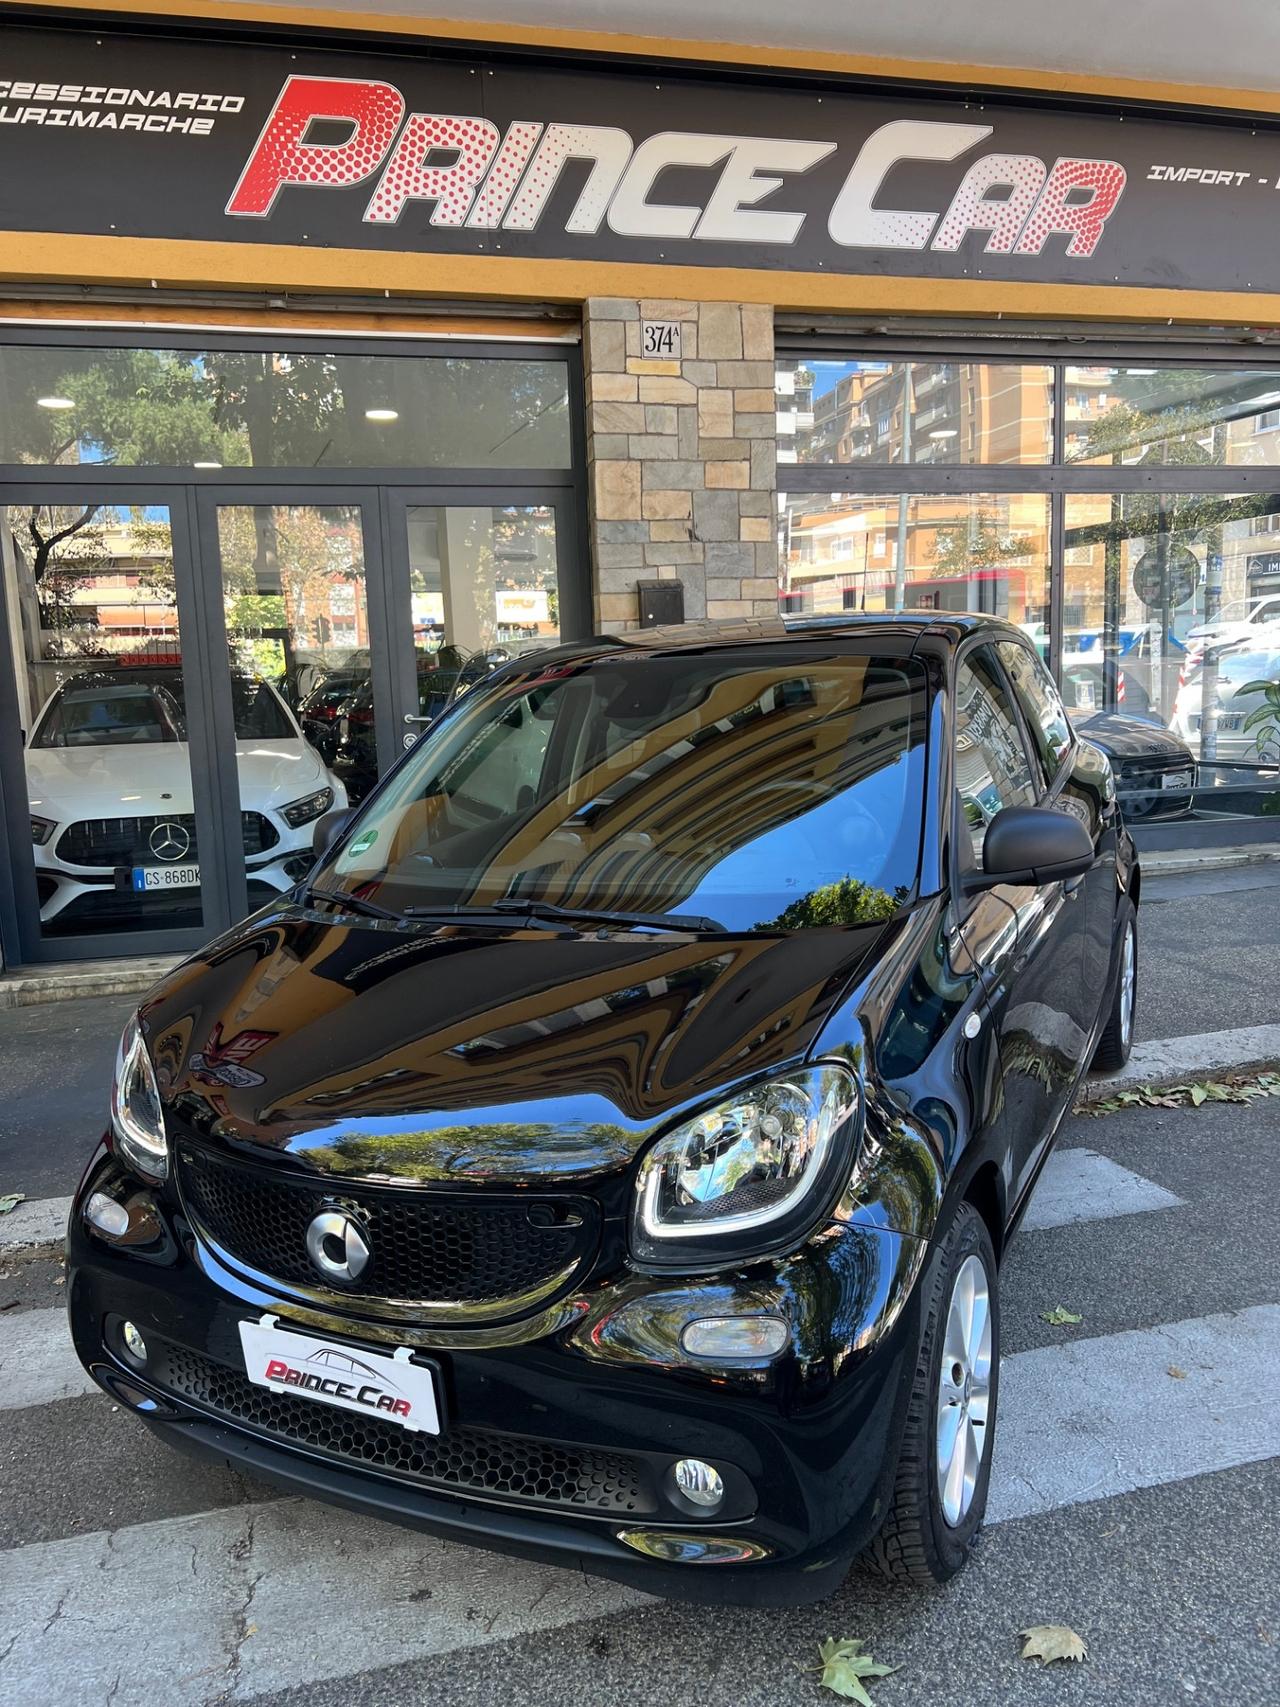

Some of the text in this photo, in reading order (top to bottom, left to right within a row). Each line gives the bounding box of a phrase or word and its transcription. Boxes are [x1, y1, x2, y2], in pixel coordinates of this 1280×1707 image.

[224, 74, 1127, 260] PRINCE CAR
[1146, 165, 1251, 187] IMPORT
[265, 1360, 412, 1417] PRINCE CAR
